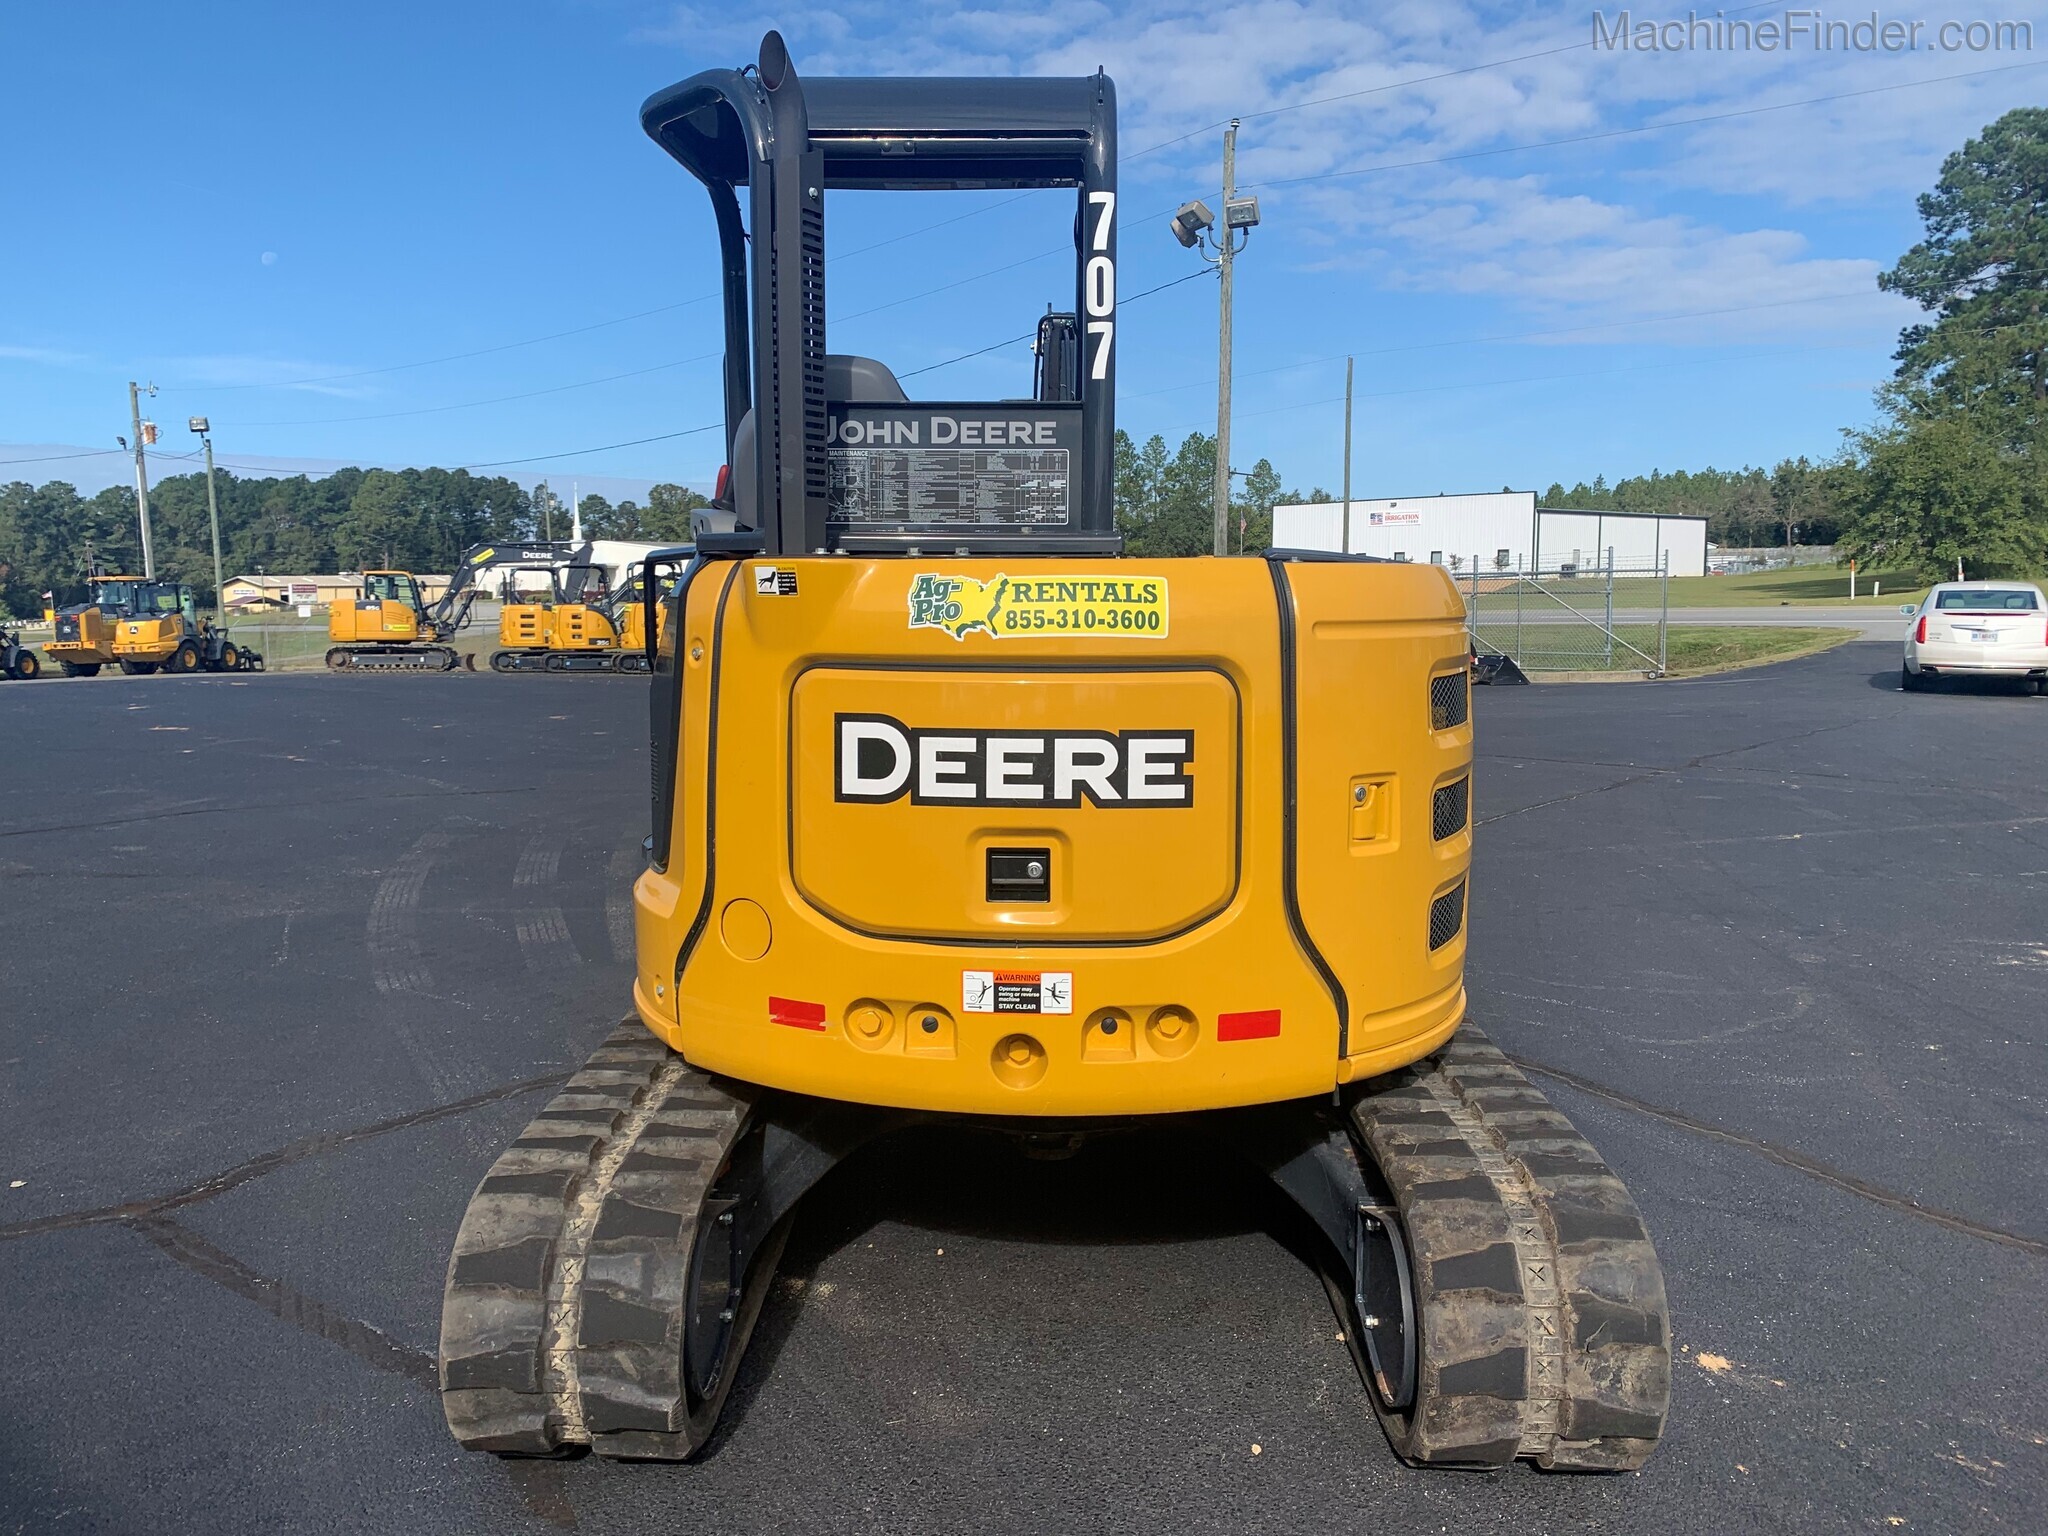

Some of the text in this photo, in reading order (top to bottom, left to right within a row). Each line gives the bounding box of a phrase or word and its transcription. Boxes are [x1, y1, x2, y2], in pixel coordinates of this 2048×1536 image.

[1086, 191, 1115, 380] 707
[827, 416, 1057, 445] JOHN DEERE
[522, 551, 553, 559] DEERE
[914, 577, 961, 598] Ag-
[1011, 582, 1157, 604] RENTALS
[913, 600, 962, 622] Pro
[1005, 608, 1160, 631] 855-310-3600
[841, 721, 1186, 800] DEERE
